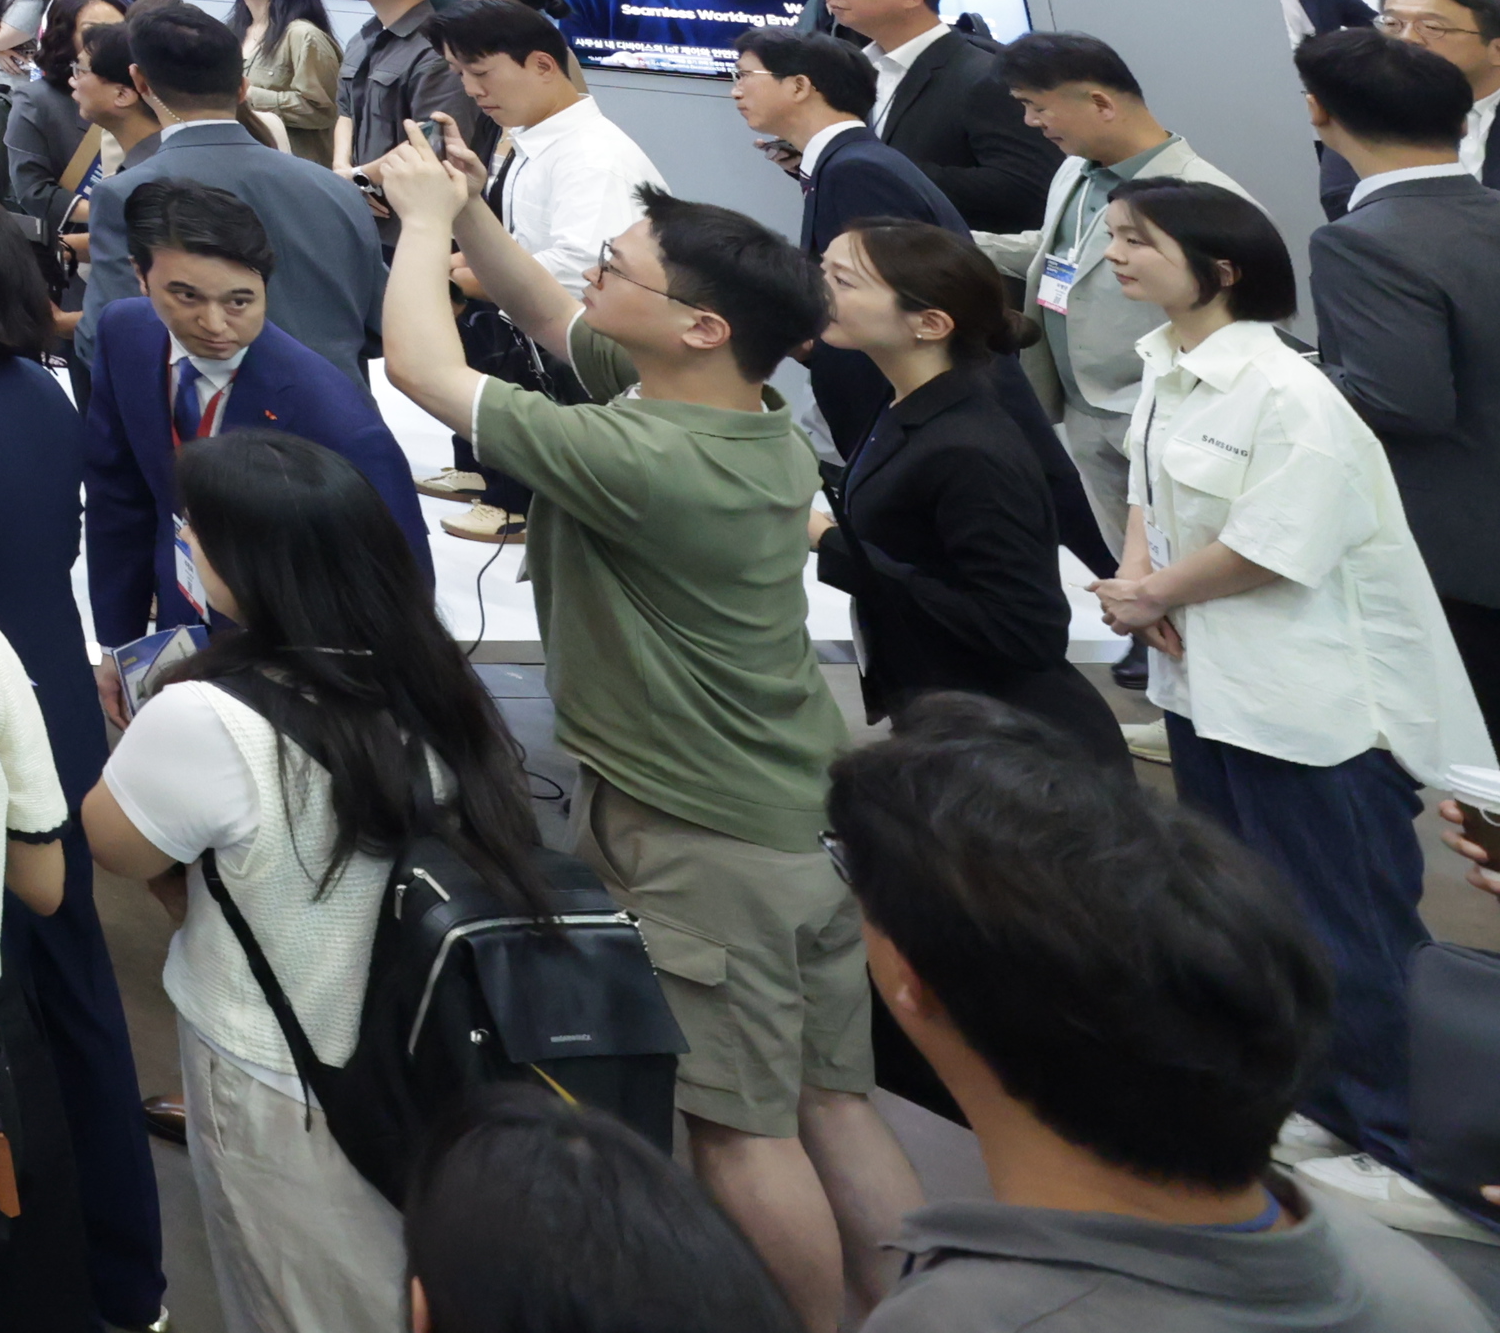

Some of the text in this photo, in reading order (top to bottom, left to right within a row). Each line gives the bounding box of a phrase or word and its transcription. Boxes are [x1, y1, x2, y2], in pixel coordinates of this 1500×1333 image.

[620, 3, 696, 21] Seamless
[698, 7, 764, 28] Working
[1201, 434, 1249, 458] SAMSUNG
